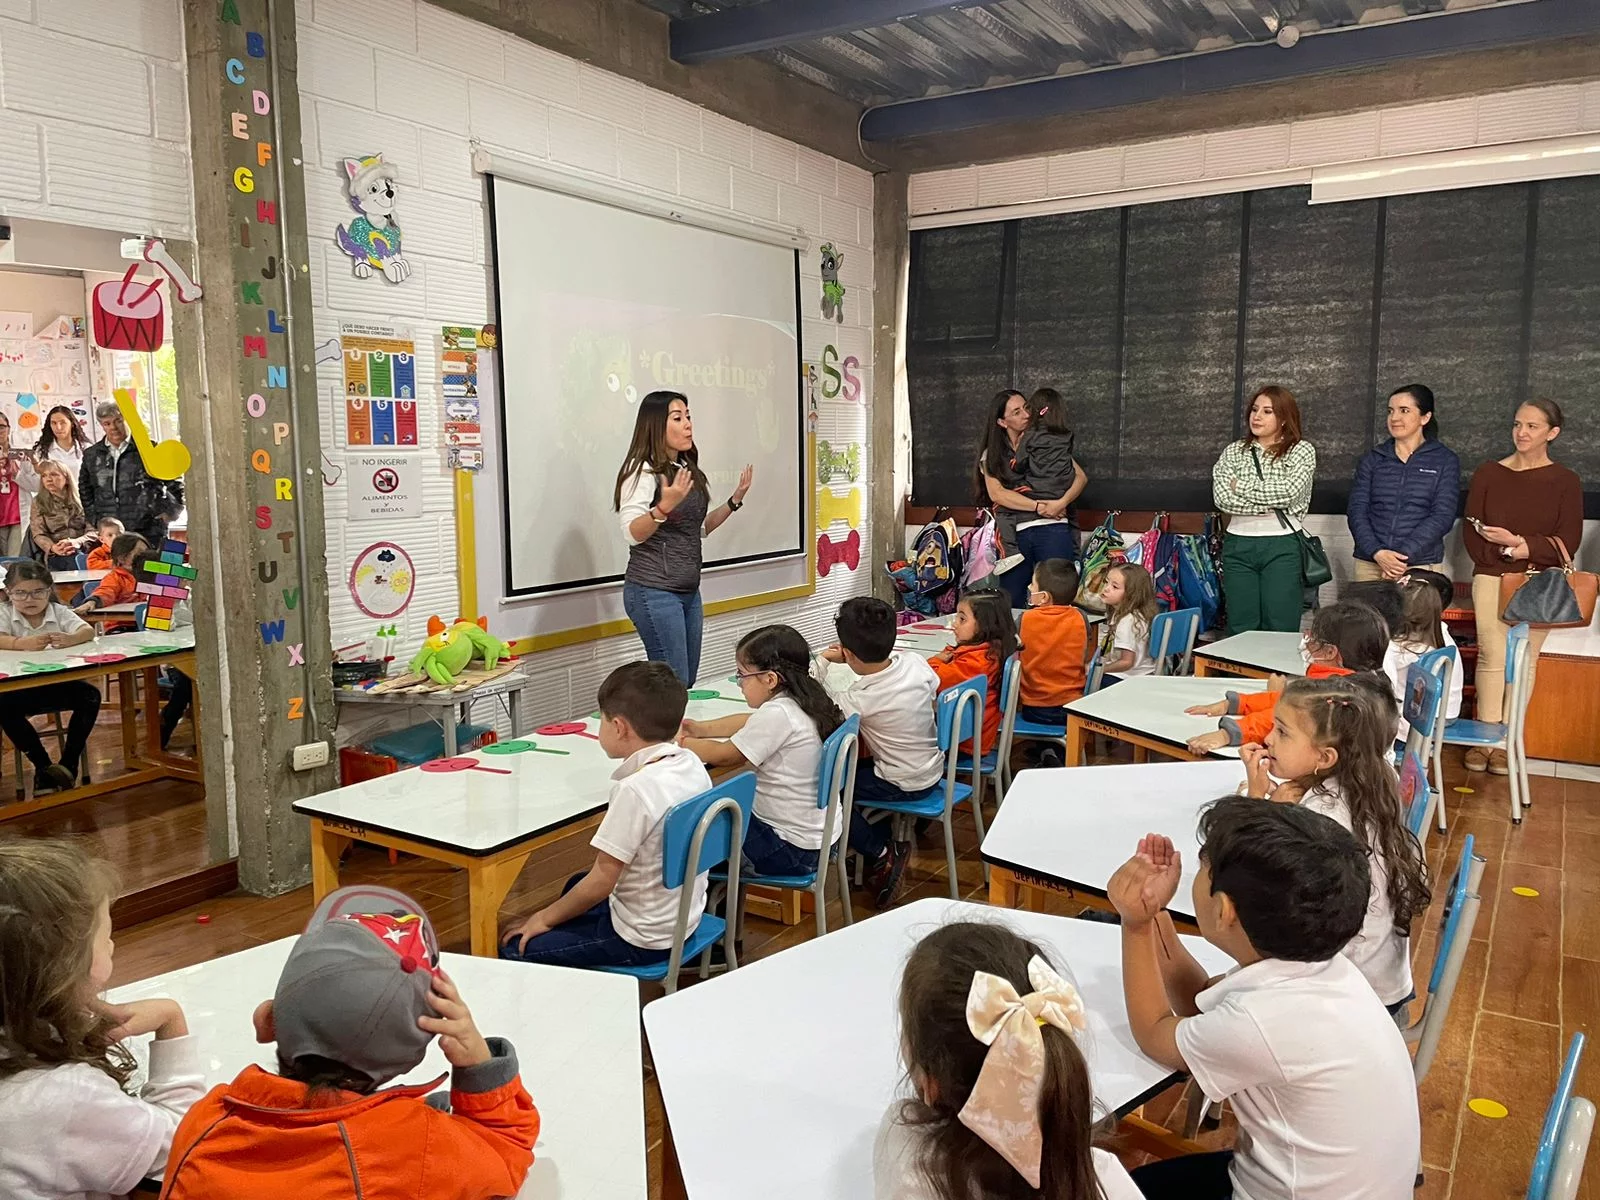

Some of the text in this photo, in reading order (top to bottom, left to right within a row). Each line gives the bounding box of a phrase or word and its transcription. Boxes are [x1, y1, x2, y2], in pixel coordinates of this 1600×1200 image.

[221, 0, 241, 25] A
[246, 32, 266, 58] B
[226, 58, 245, 86] C
[252, 90, 270, 116] D
[231, 112, 249, 140] E
[257, 142, 273, 166] F
[234, 167, 255, 193] G
[256, 200, 277, 224] H
[262, 256, 276, 280] J
[241, 281, 263, 306] K
[268, 310, 285, 333] L
[243, 335, 267, 358] M
[375, 351, 383, 360] 2
[400, 352, 407, 362] 3
[267, 366, 287, 389] N
[247, 393, 266, 418] O
[354, 398, 361, 407] 4
[379, 399, 386, 409] 5
[402, 400, 409, 409] 6
[273, 422, 290, 446] P
[251, 449, 271, 474] Q
[362, 458, 408, 466] NO INGERIR
[275, 478, 293, 501] R
[255, 505, 272, 529] S
[277, 531, 294, 553] T
[258, 560, 278, 584] U
[282, 588, 300, 610] V
[260, 619, 286, 645] W
[287, 643, 305, 667] X
[287, 697, 304, 720] Z
